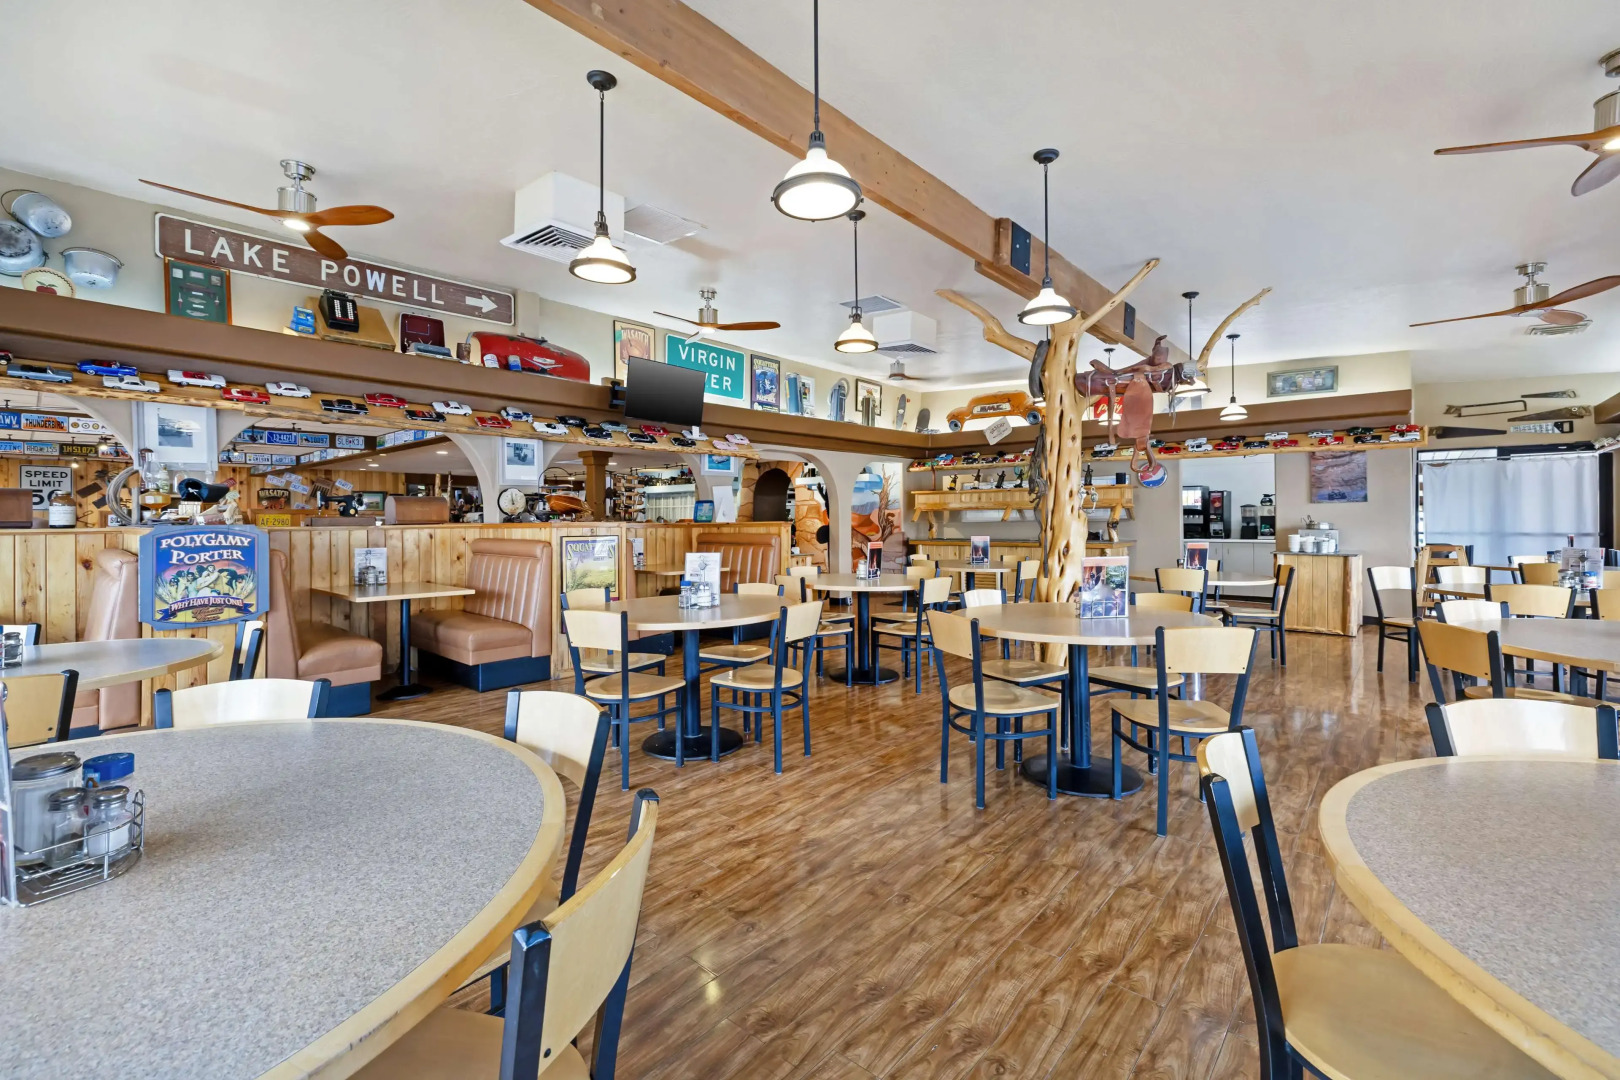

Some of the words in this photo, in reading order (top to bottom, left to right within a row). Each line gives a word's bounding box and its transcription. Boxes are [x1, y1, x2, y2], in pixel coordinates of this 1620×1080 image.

[184, 228, 290, 274] LAKE
[321, 258, 445, 305] POWELL
[678, 344, 736, 372] VIRGIN
[25, 470, 68, 478] SPEED
[29, 480, 64, 488] LIMIT
[160, 533, 252, 548] POLYGAMY
[170, 601, 189, 612] WHY
[189, 598, 209, 607] HAVE
[209, 597, 225, 606] JUST
